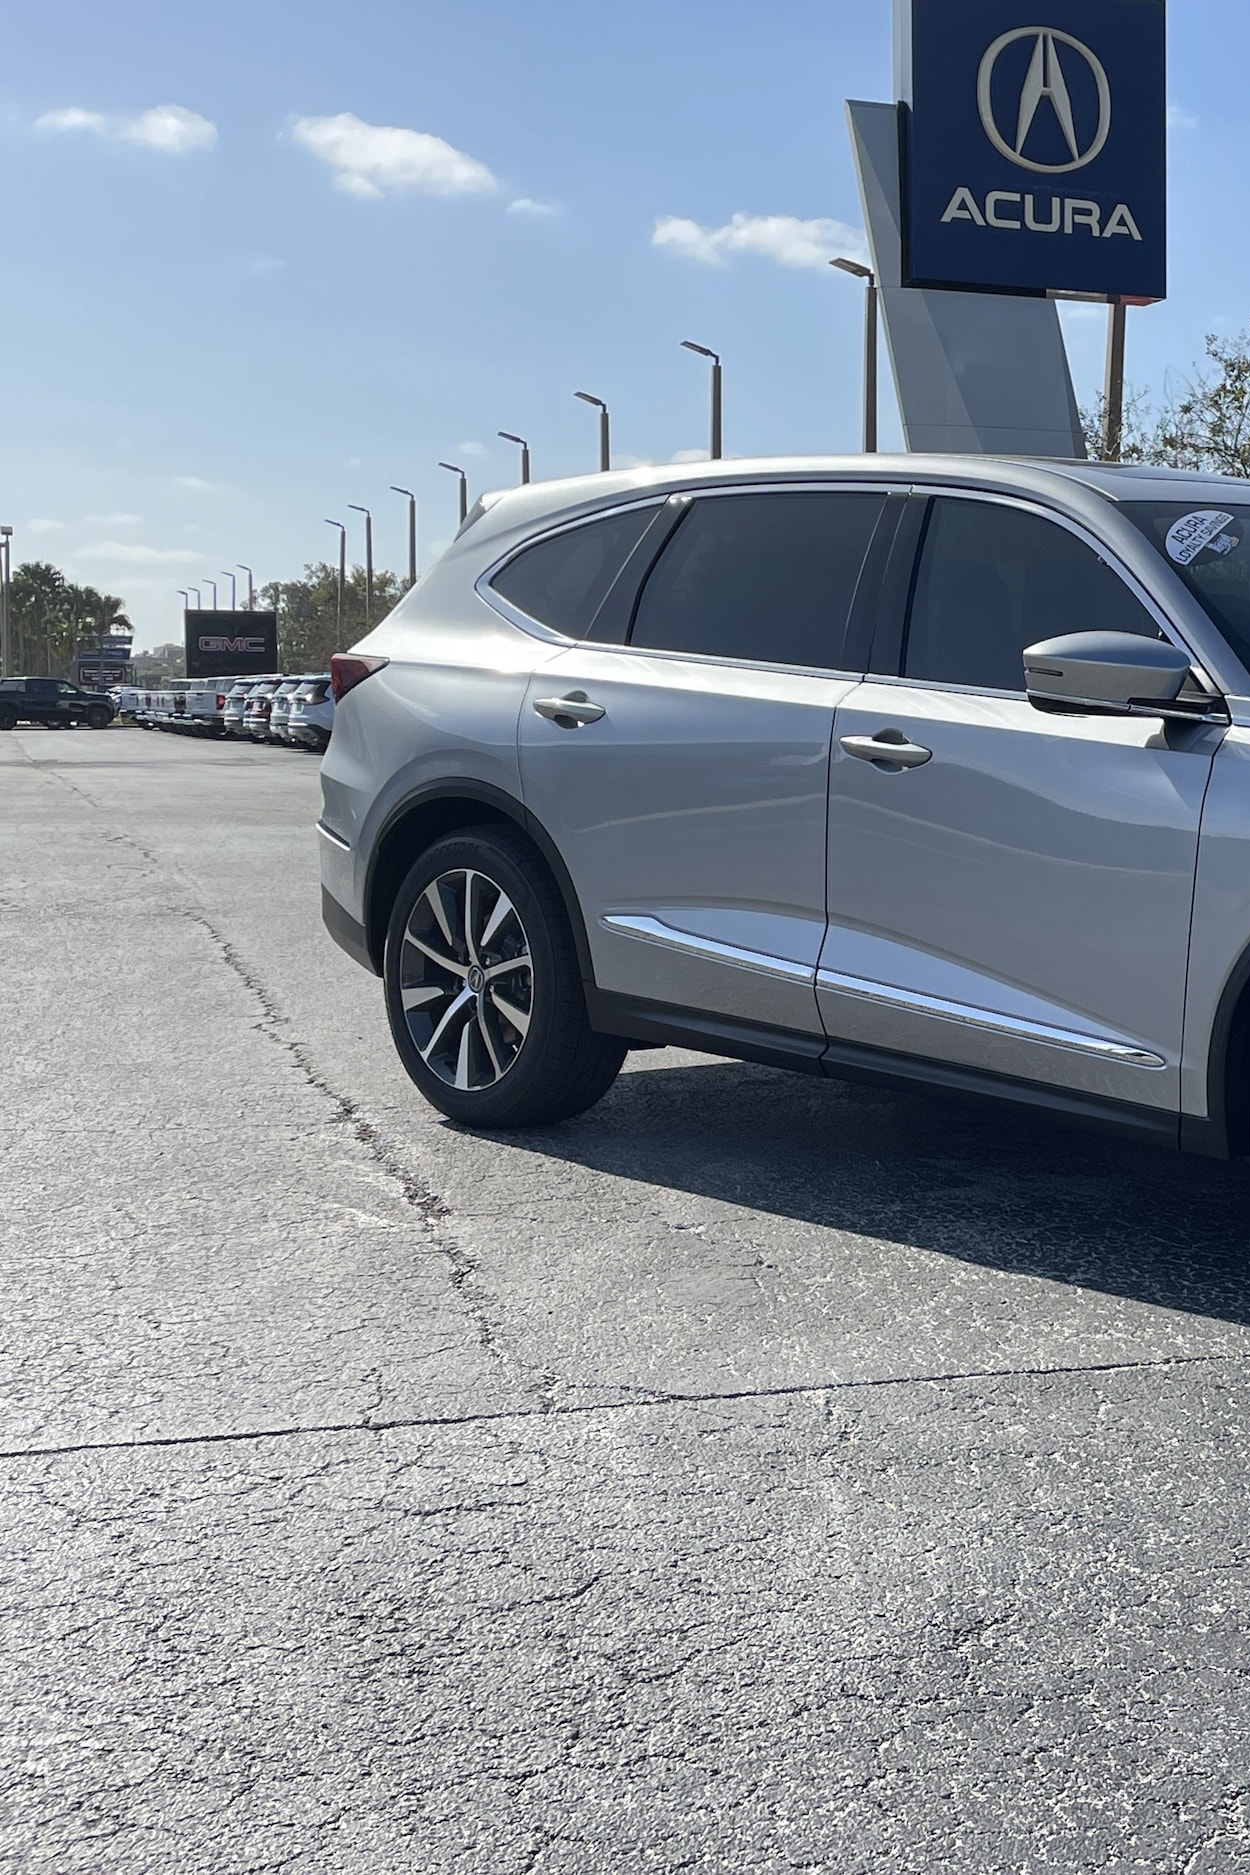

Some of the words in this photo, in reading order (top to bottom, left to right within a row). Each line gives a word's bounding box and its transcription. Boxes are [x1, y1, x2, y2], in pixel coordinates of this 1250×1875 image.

[941, 187, 1142, 240] ACURA
[1171, 516, 1207, 545] ACURA
[1176, 533, 1206, 562] LOYALTY
[199, 636, 265, 652] GMC
